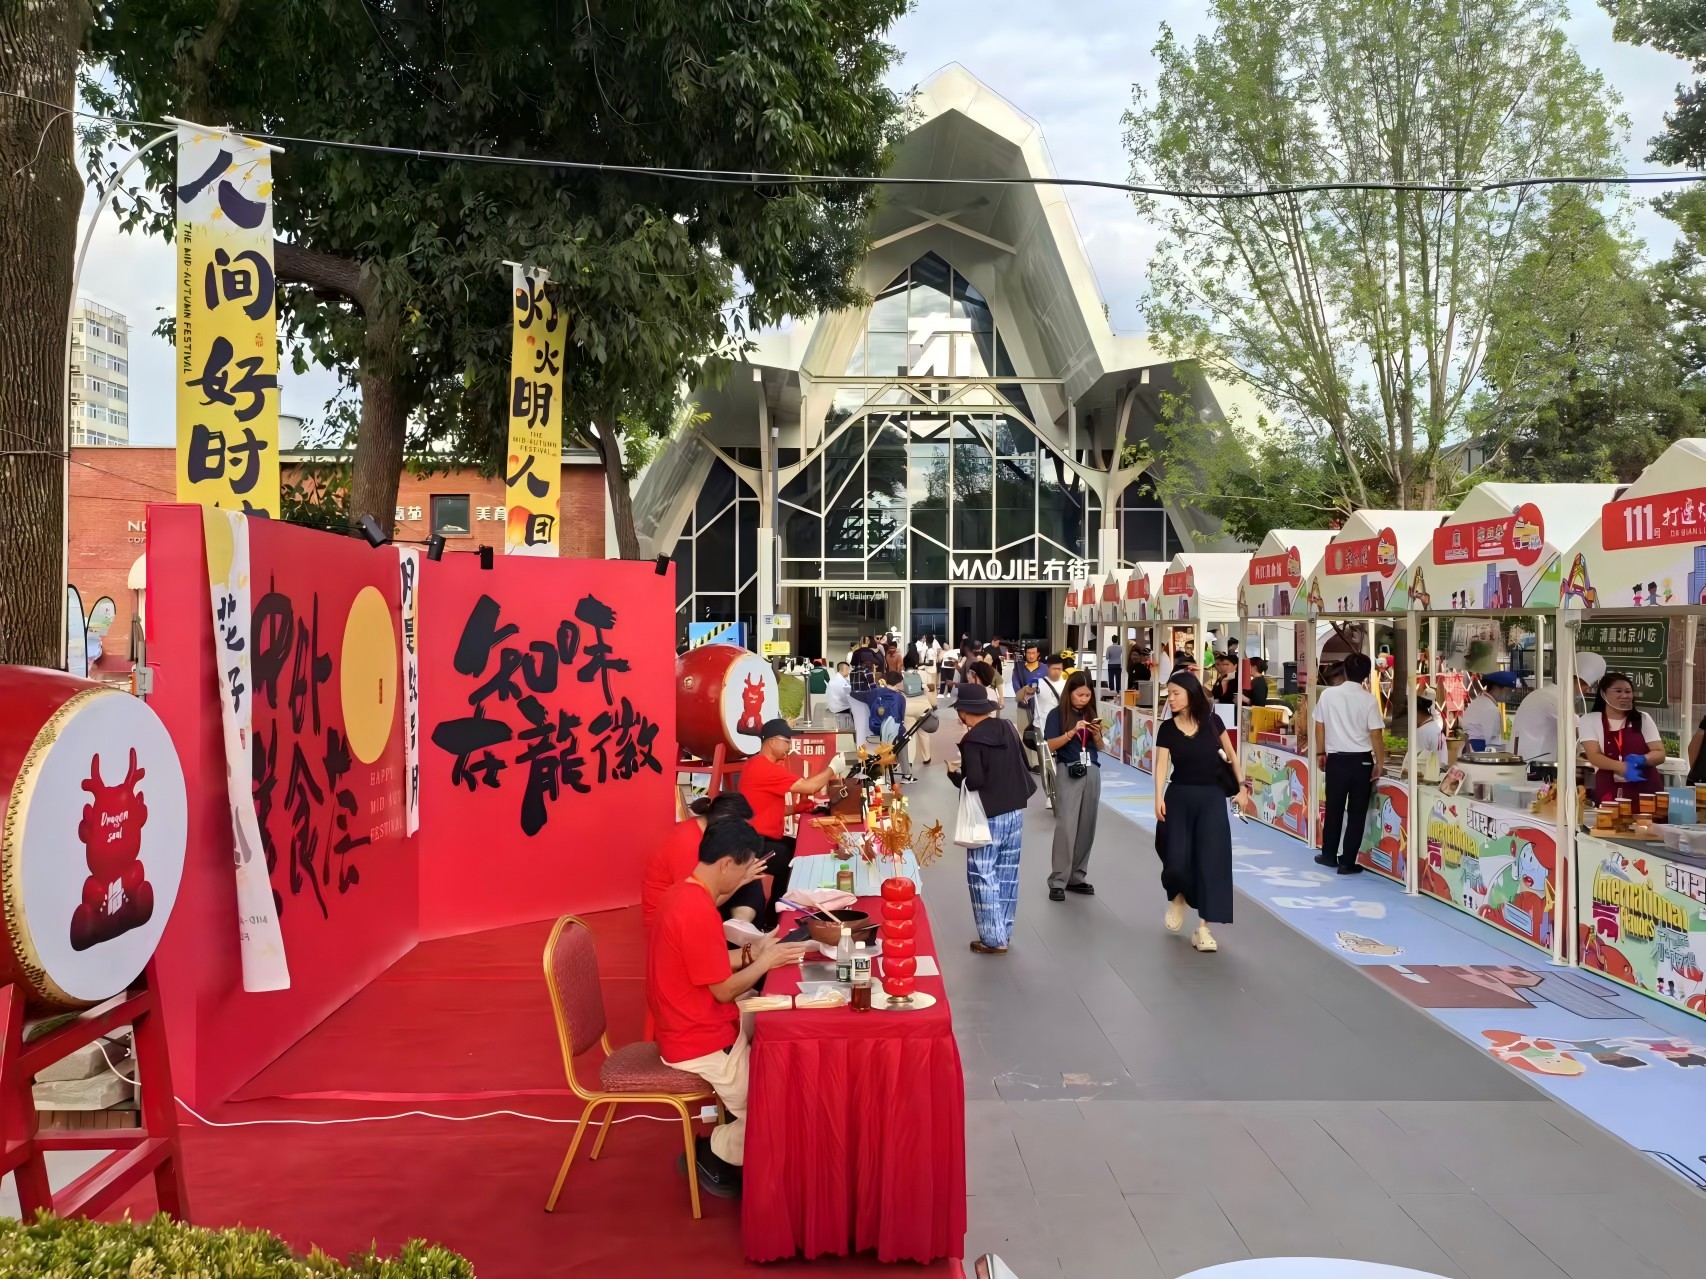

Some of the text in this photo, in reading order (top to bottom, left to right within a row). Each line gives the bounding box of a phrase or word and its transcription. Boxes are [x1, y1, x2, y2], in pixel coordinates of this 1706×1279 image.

[177, 149, 277, 518] 人间好时
[184, 222, 192, 374] THE MID-AUTUMN FESTIVAL
[950, 559, 1037, 581] MAOJIE
